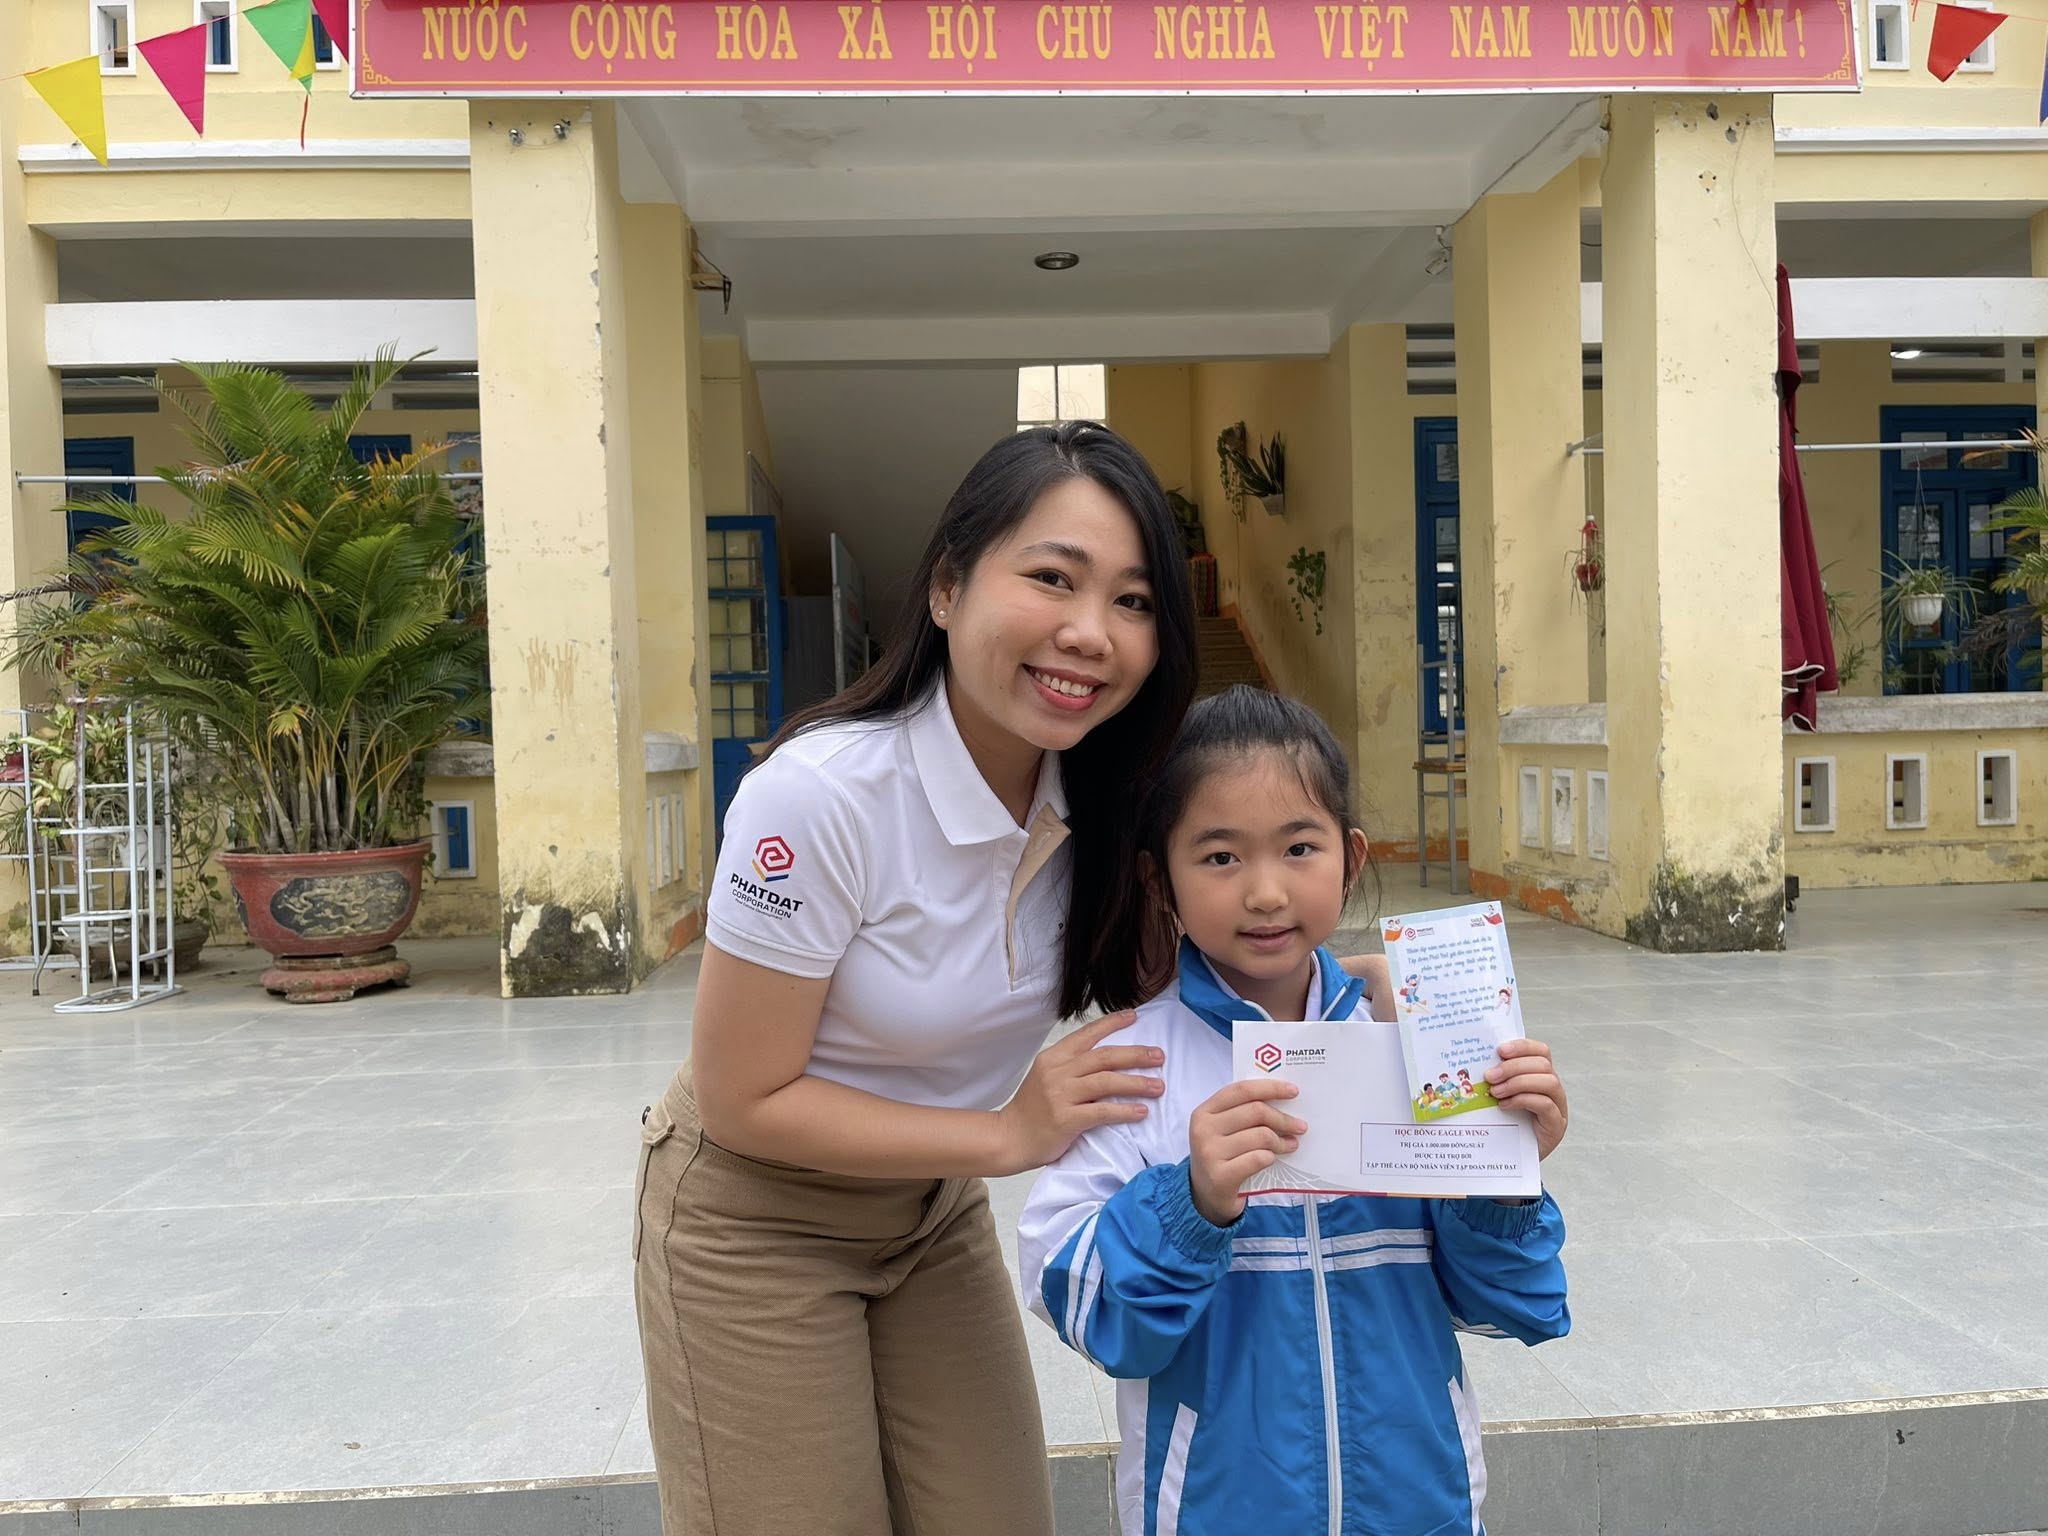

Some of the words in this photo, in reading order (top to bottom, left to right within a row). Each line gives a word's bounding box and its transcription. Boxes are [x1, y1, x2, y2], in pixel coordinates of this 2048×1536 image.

[422, 0, 527, 61] NƯỚC
[570, 0, 677, 74] CỘNG
[926, 0, 998, 75] HỘI
[1153, 0, 1276, 60] NGHĨA
[1314, 0, 1409, 73] VIỆT
[1449, 5, 1532, 59] NAM
[1567, 0, 1674, 59] MUÔN
[730, 872, 803, 912] PHATDAT
[731, 888, 792, 919] CORPORATION
[1286, 1048, 1326, 1056] PHATDAT
[1394, 1128, 1412, 1137] HỌC
[1438, 1128, 1464, 1136] EAGLE
